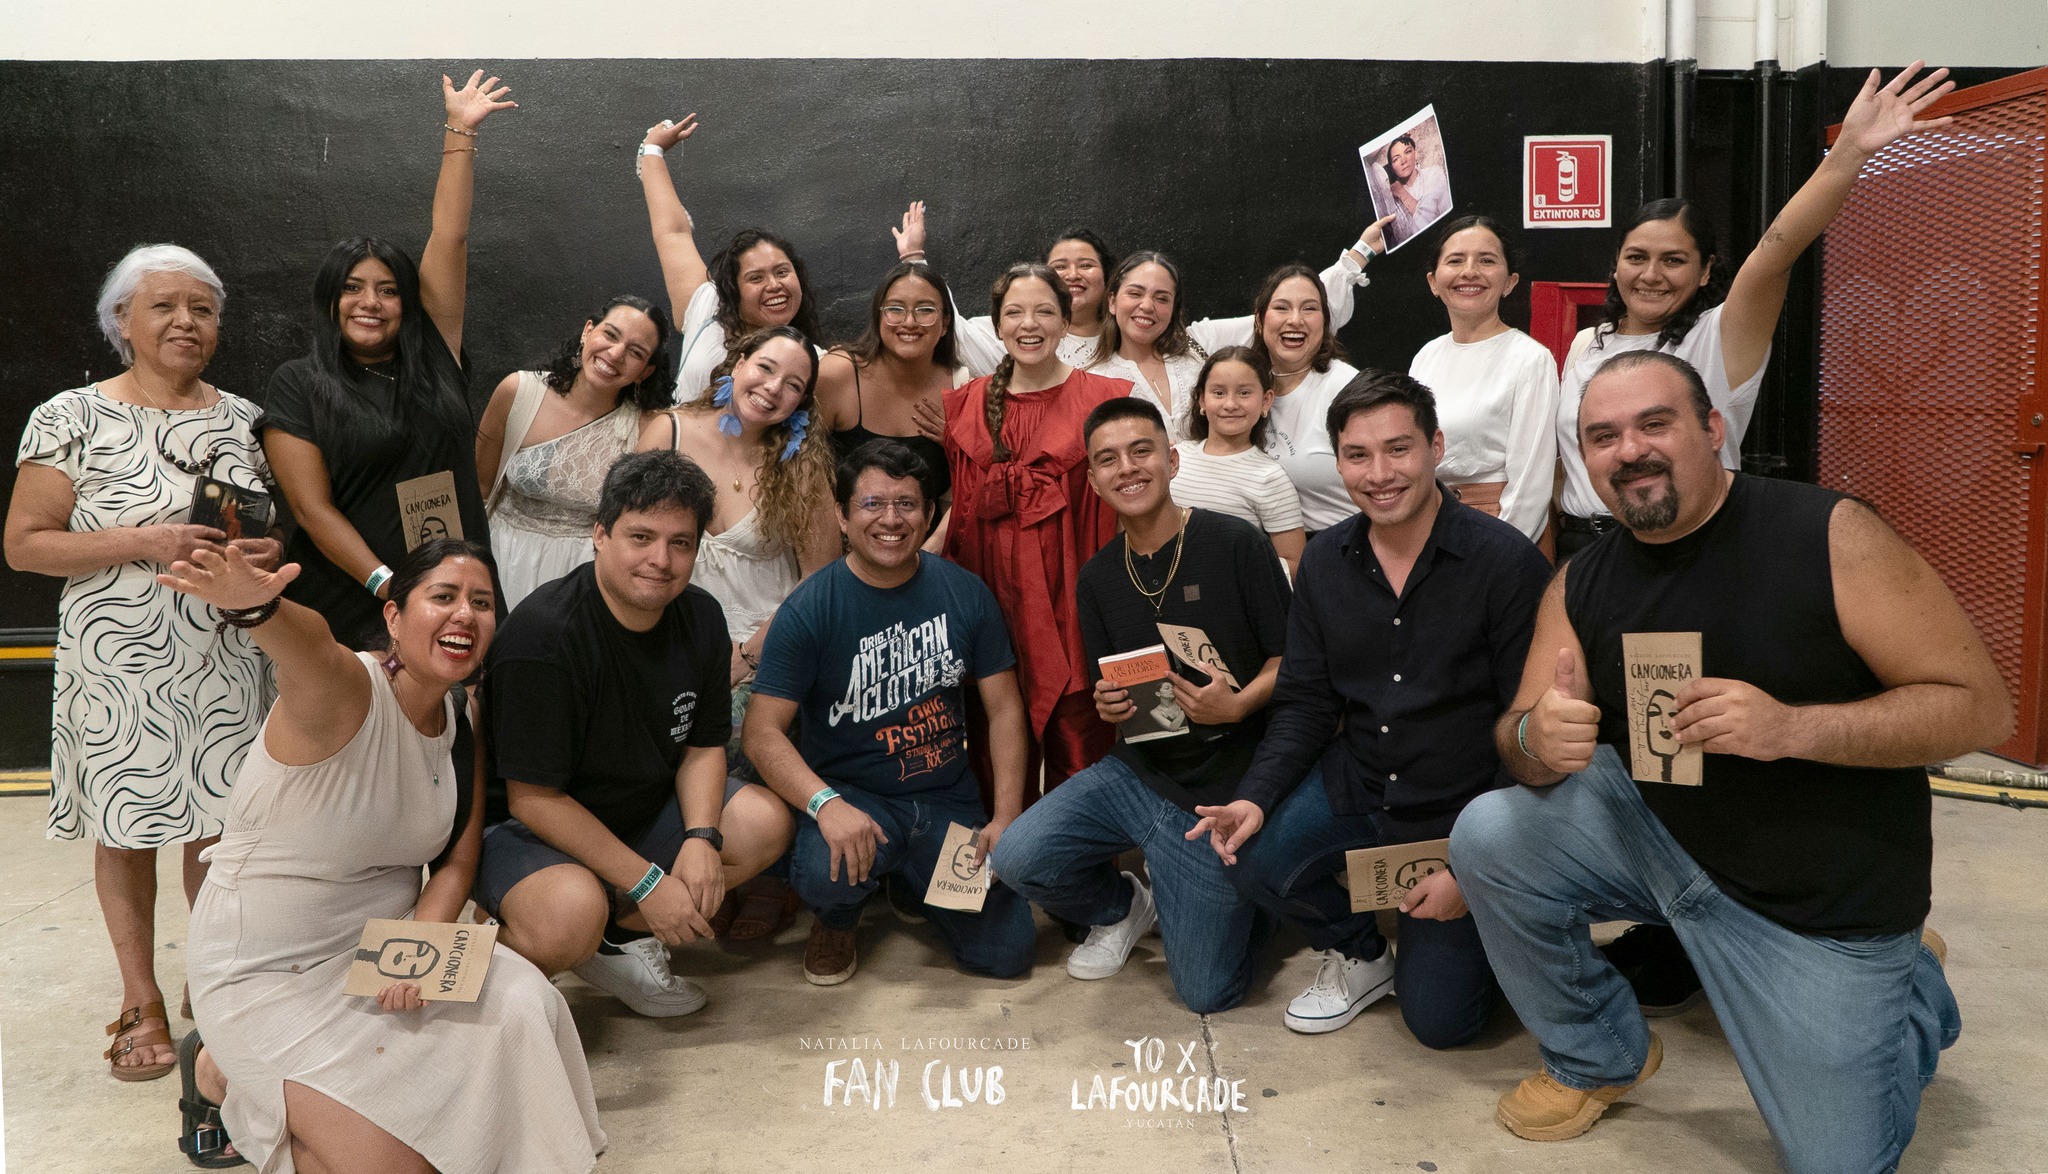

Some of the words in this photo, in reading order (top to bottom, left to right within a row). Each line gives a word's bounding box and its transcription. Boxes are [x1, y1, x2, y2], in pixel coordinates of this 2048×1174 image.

[1533, 209, 1580, 219] EXTINTOR
[1582, 208, 1601, 219] PQS
[405, 493, 452, 515] CANCIONERA
[828, 613, 949, 728] AMERICAN
[1110, 671, 1126, 680] LAS
[1128, 664, 1160, 676] FLORES
[1113, 665, 1124, 673] DE
[1126, 659, 1154, 670] TODAS
[1630, 663, 1692, 681] CANCIONERA
[862, 649, 955, 722] CLOTHES
[673, 701, 696, 715] GOLFO
[680, 713, 690, 723] DE
[646, 867, 661, 883] MEET
[1374, 858, 1389, 905] CANCIONERA
[937, 880, 982, 894] CANCIONERA
[439, 929, 470, 993] CANCIONERA
